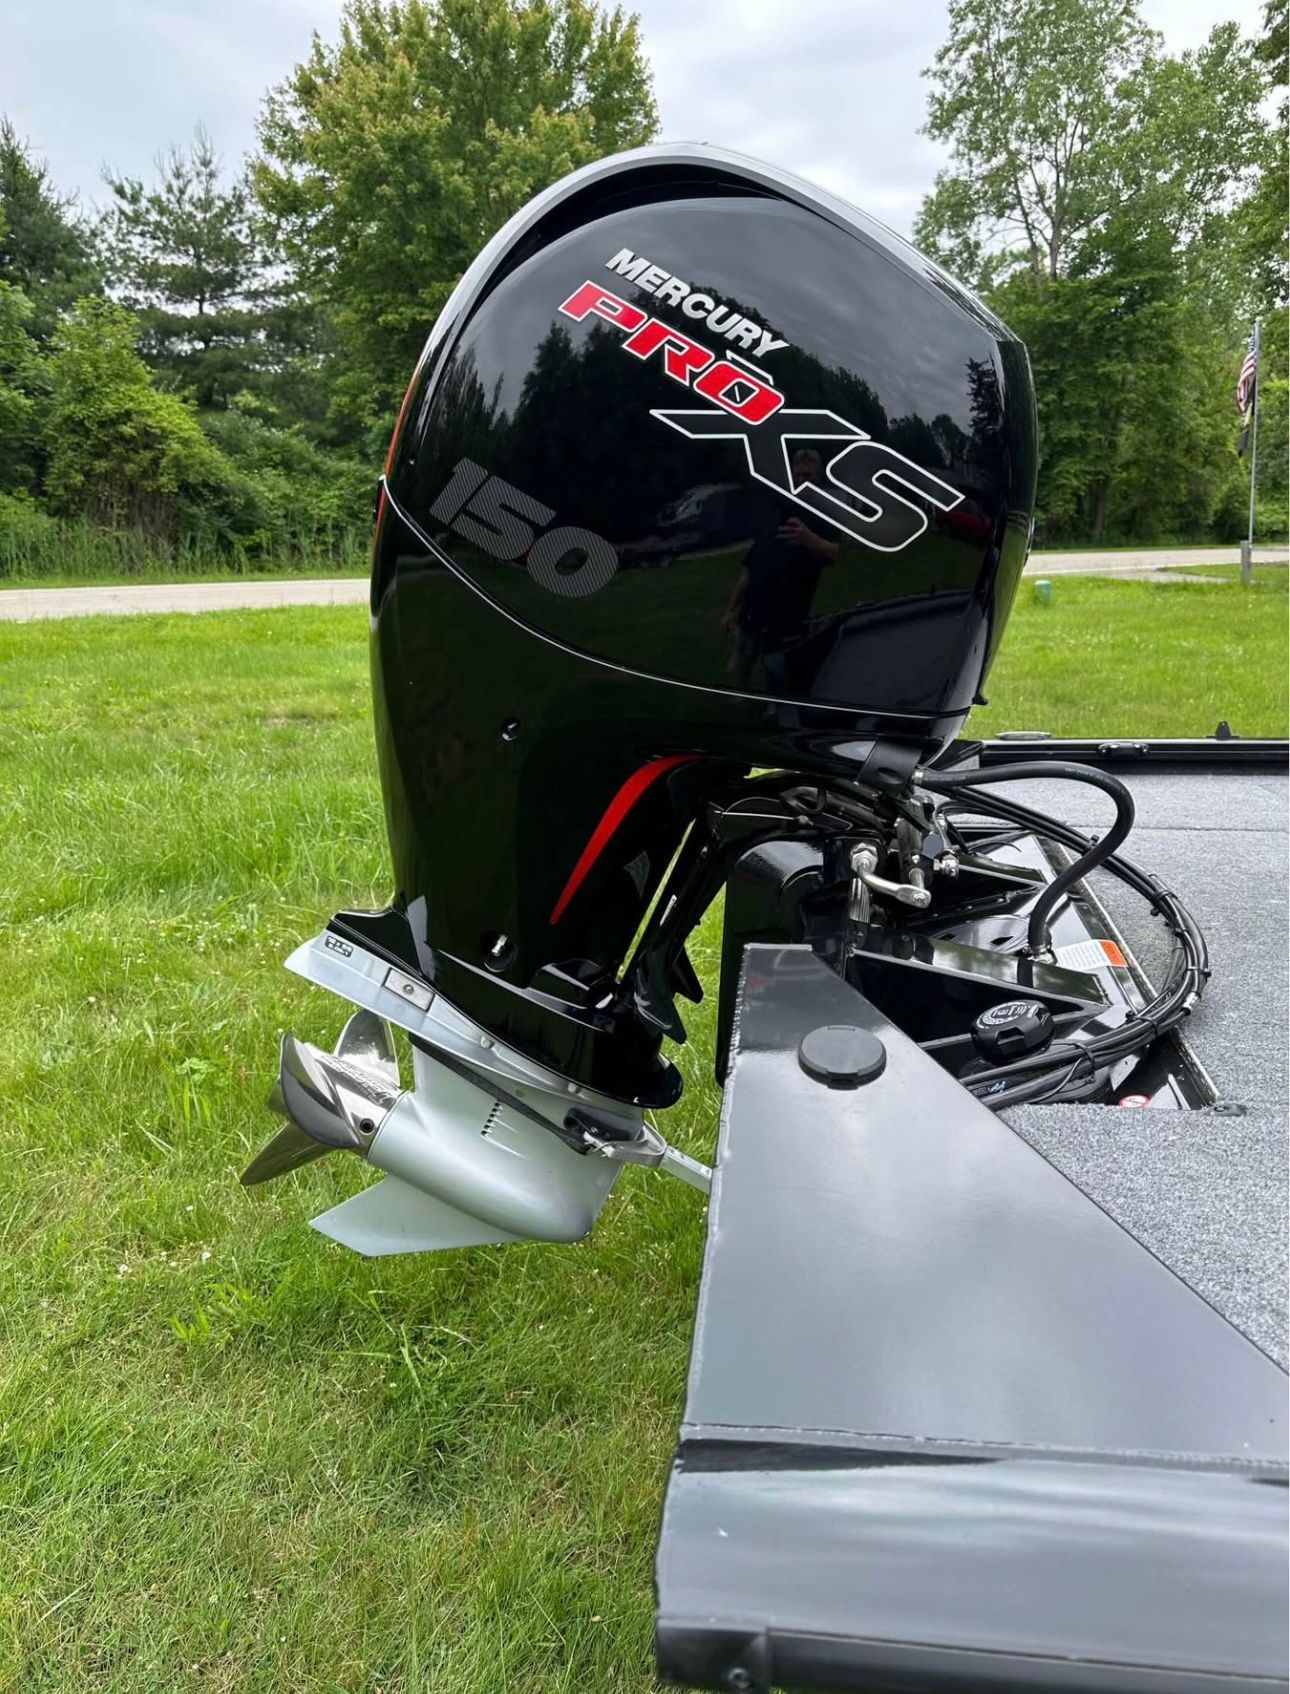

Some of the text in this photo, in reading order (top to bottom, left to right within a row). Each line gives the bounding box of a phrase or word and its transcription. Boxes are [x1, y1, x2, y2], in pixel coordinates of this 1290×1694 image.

[606, 248, 789, 357] MERCURY
[558, 280, 965, 552] PRO XS
[429, 457, 619, 598] 150
